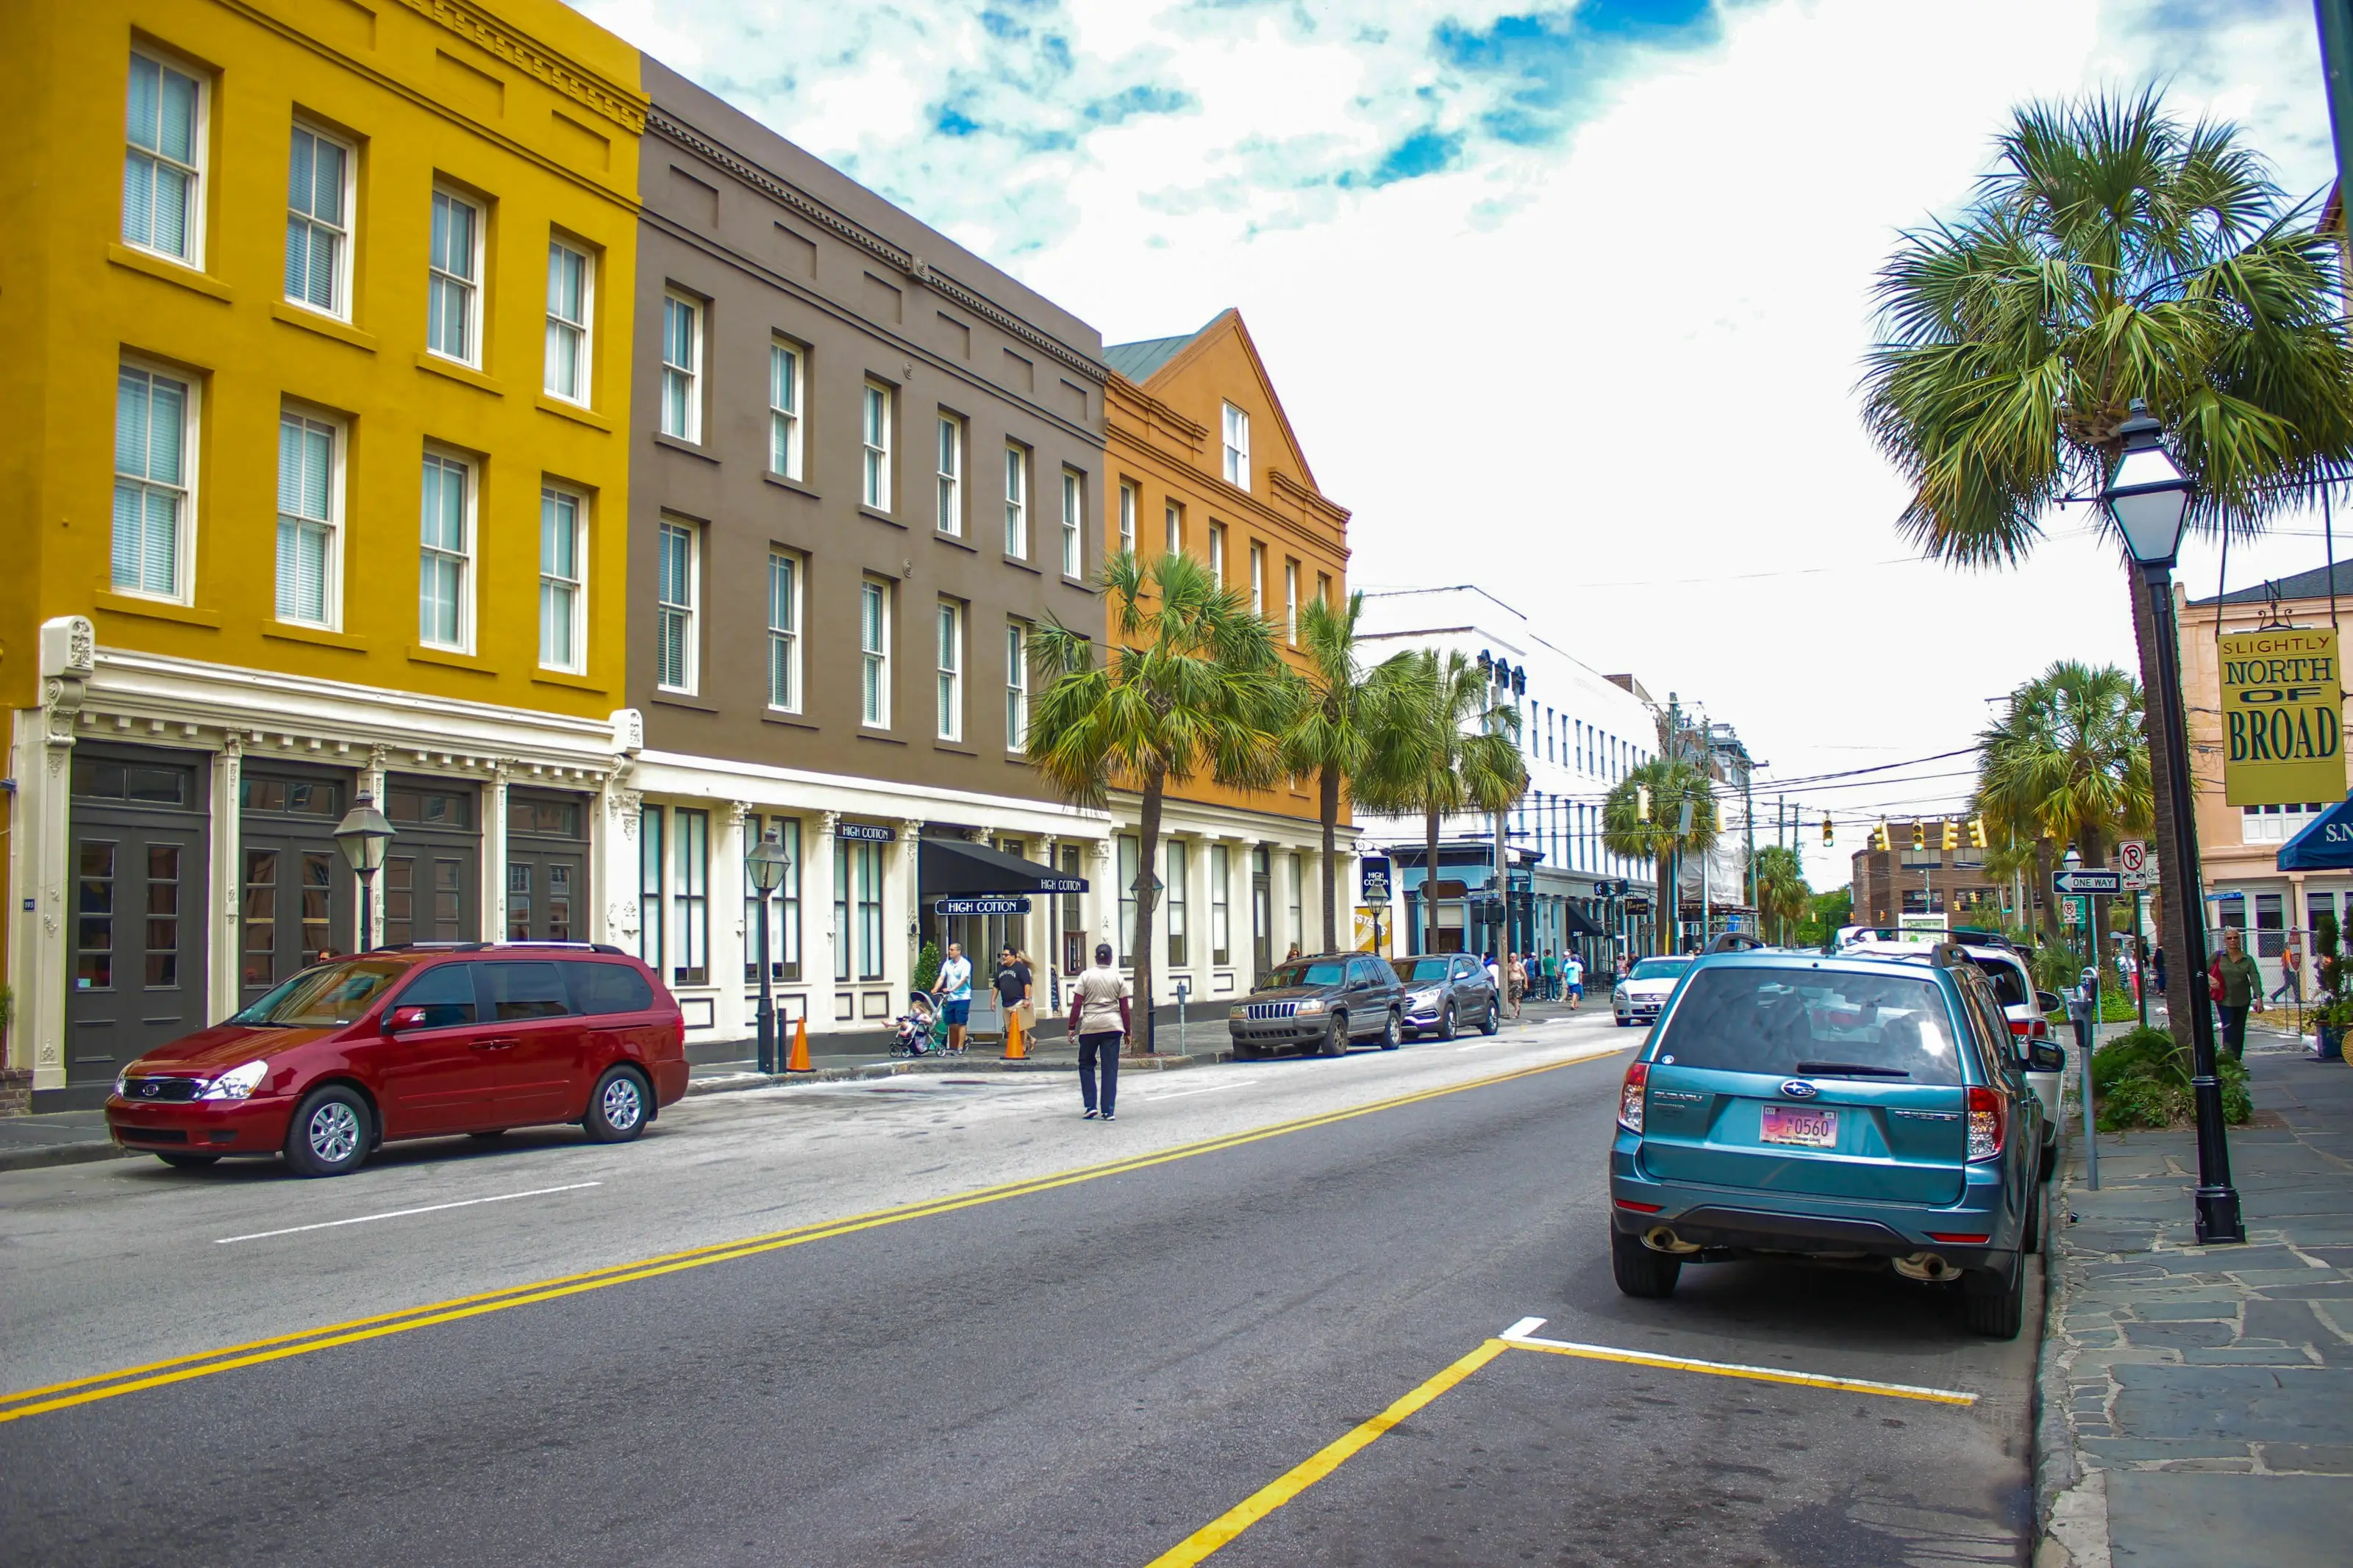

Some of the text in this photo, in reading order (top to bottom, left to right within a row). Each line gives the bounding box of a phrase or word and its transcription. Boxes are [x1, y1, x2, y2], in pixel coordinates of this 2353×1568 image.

[2223, 637, 2330, 654] SLIGHTLY
[2224, 658, 2334, 684] NORTH
[2239, 687, 2322, 703] OF
[2226, 706, 2338, 762] BROAD
[843, 826, 888, 840] HIGH COTTON
[1040, 878, 1081, 891] HIGH COTTON
[2073, 878, 2113, 887] ONE WAY
[948, 901, 1017, 912] HIGH COTTON
[1654, 1091, 1703, 1101] SUBARU
[1795, 1118, 1829, 1136] 0560
